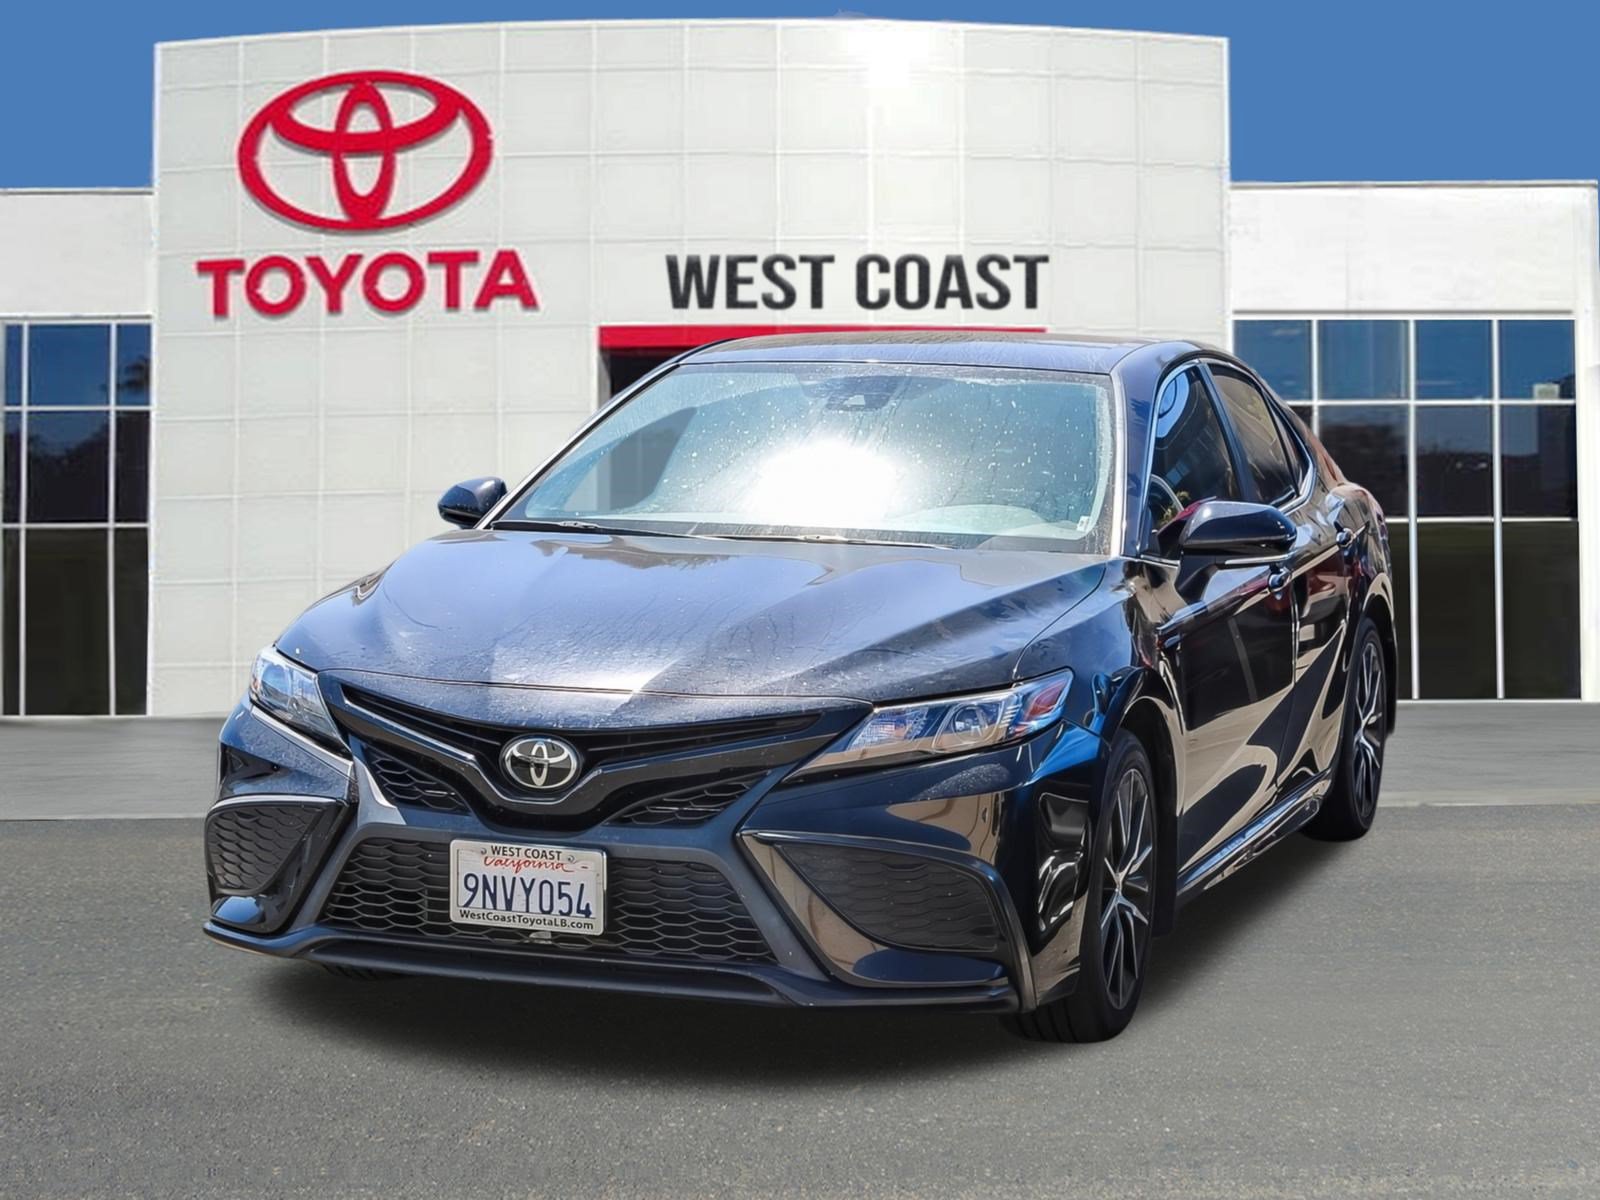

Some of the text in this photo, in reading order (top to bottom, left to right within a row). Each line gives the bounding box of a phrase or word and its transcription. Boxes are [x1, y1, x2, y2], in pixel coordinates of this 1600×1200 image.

[196, 249, 540, 320] TOYOTA
[665, 253, 1050, 310] WEST COAST
[490, 845, 562, 861] WEST COAST
[463, 873, 593, 918] 9NVY054
[459, 909, 594, 930] WestCoastToyotaLB.com
